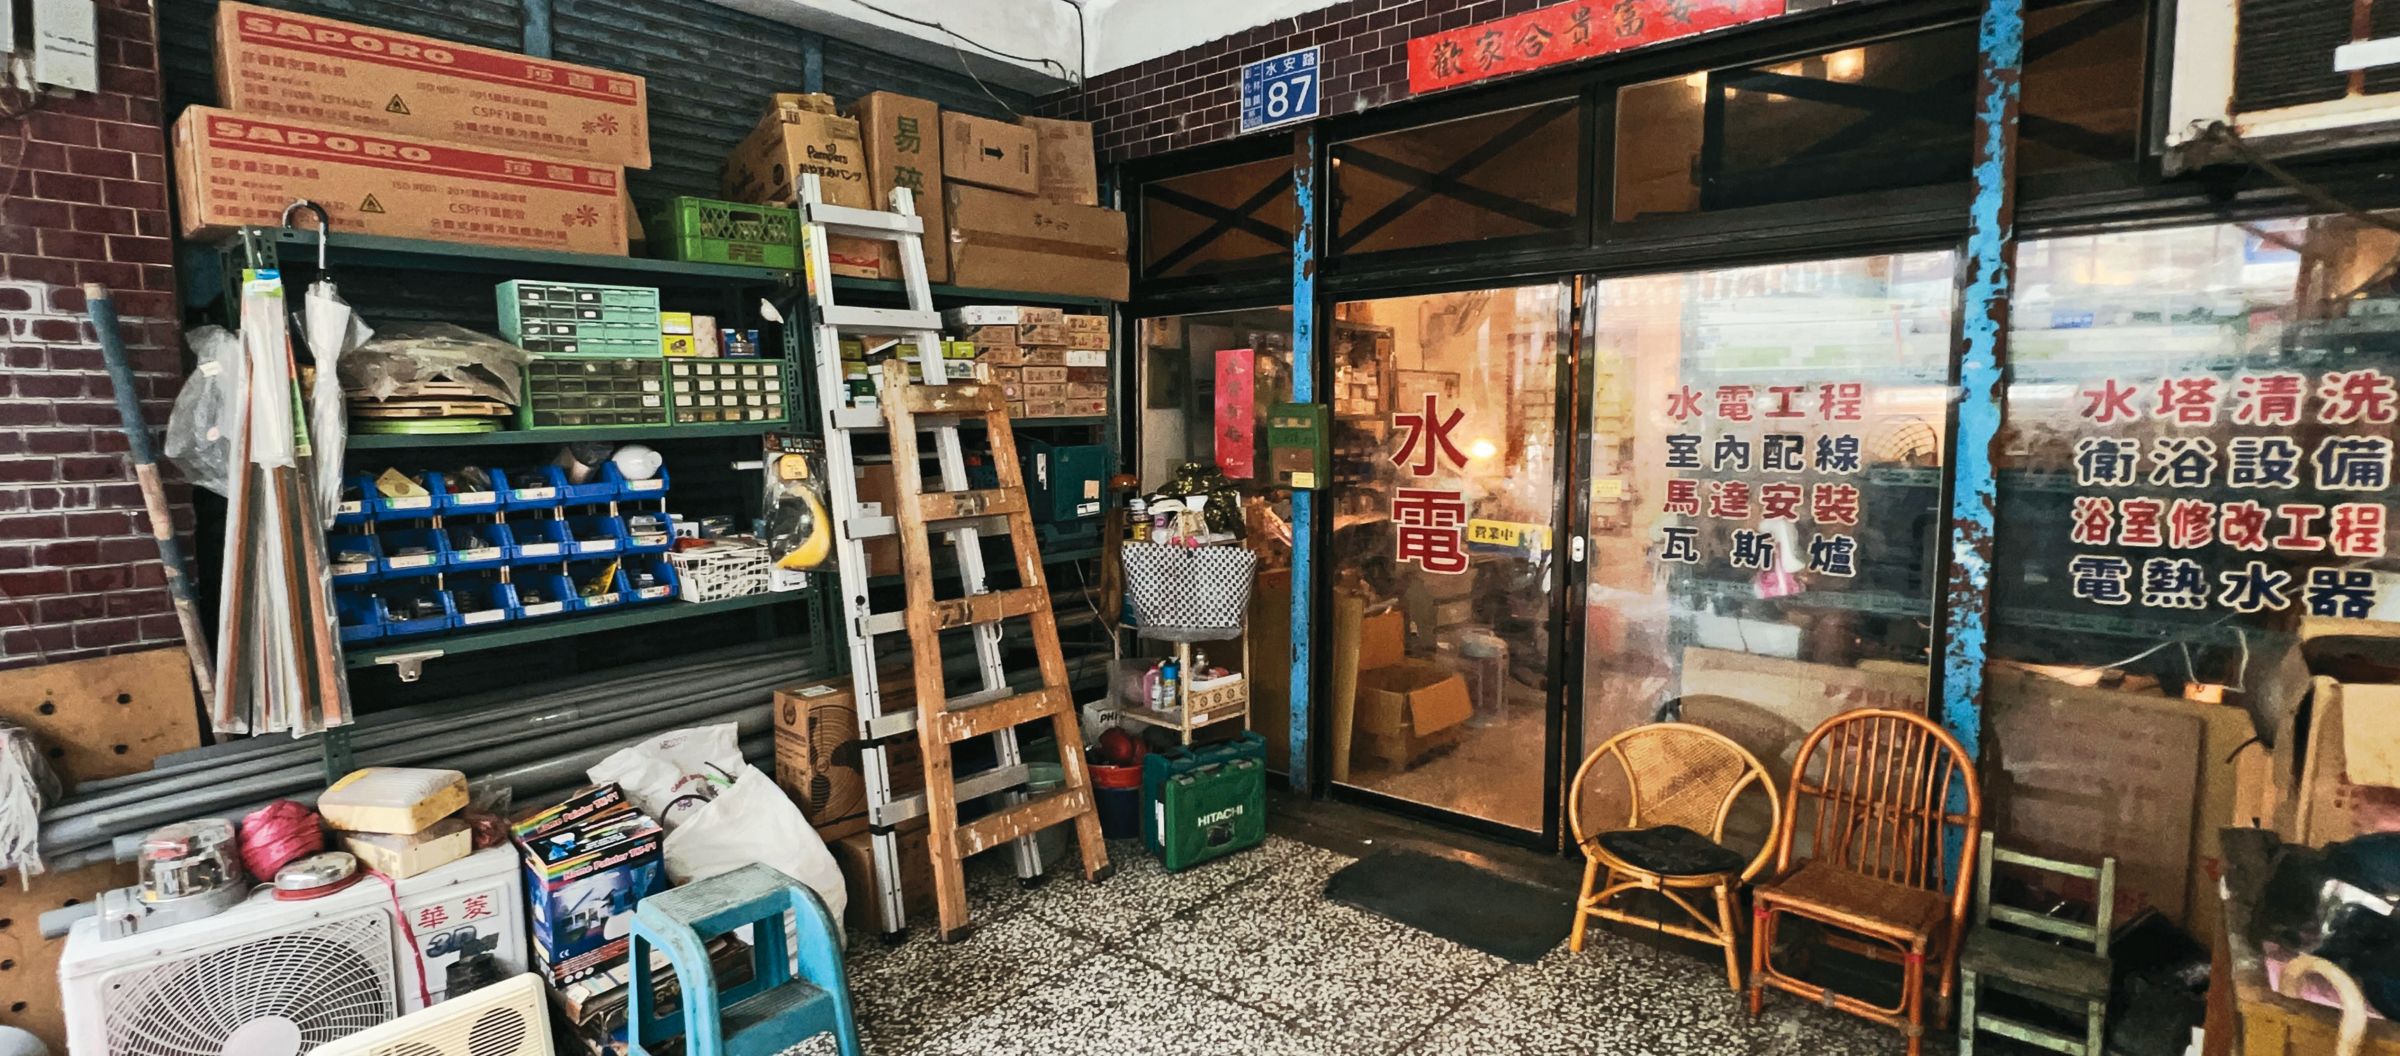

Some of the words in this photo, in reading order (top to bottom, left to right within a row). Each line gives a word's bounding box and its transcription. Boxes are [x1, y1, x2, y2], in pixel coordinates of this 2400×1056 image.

[243, 14, 455, 65] SAPORO
[1265, 52, 1315, 76] 水安路
[1267, 74, 1312, 118] 87
[214, 119, 433, 164] SAPORO
[807, 144, 849, 165] Pampers
[893, 114, 925, 200] 易碎
[799, 162, 862, 182] おやすみパンツ
[1666, 382, 1863, 422] 水電工程
[2080, 370, 2397, 424] 水塔清洗
[1664, 432, 1860, 472] 室內配線
[2076, 437, 2389, 489] 衛浴設備
[1389, 392, 1469, 575] 水電
[1662, 479, 1859, 525] 馬達安裝
[1474, 525, 1514, 541] 營業中
[2072, 499, 2386, 555] 浴室修改工程
[1661, 526, 1856, 576] 瓦斯爐
[2071, 557, 2378, 619] 電熱水器
[562, 803, 594, 822] Painter
[1197, 805, 1244, 828] HITACHI
[563, 864, 594, 880] Home
[593, 852, 629, 870] Painter
[417, 894, 493, 929] 華菱
